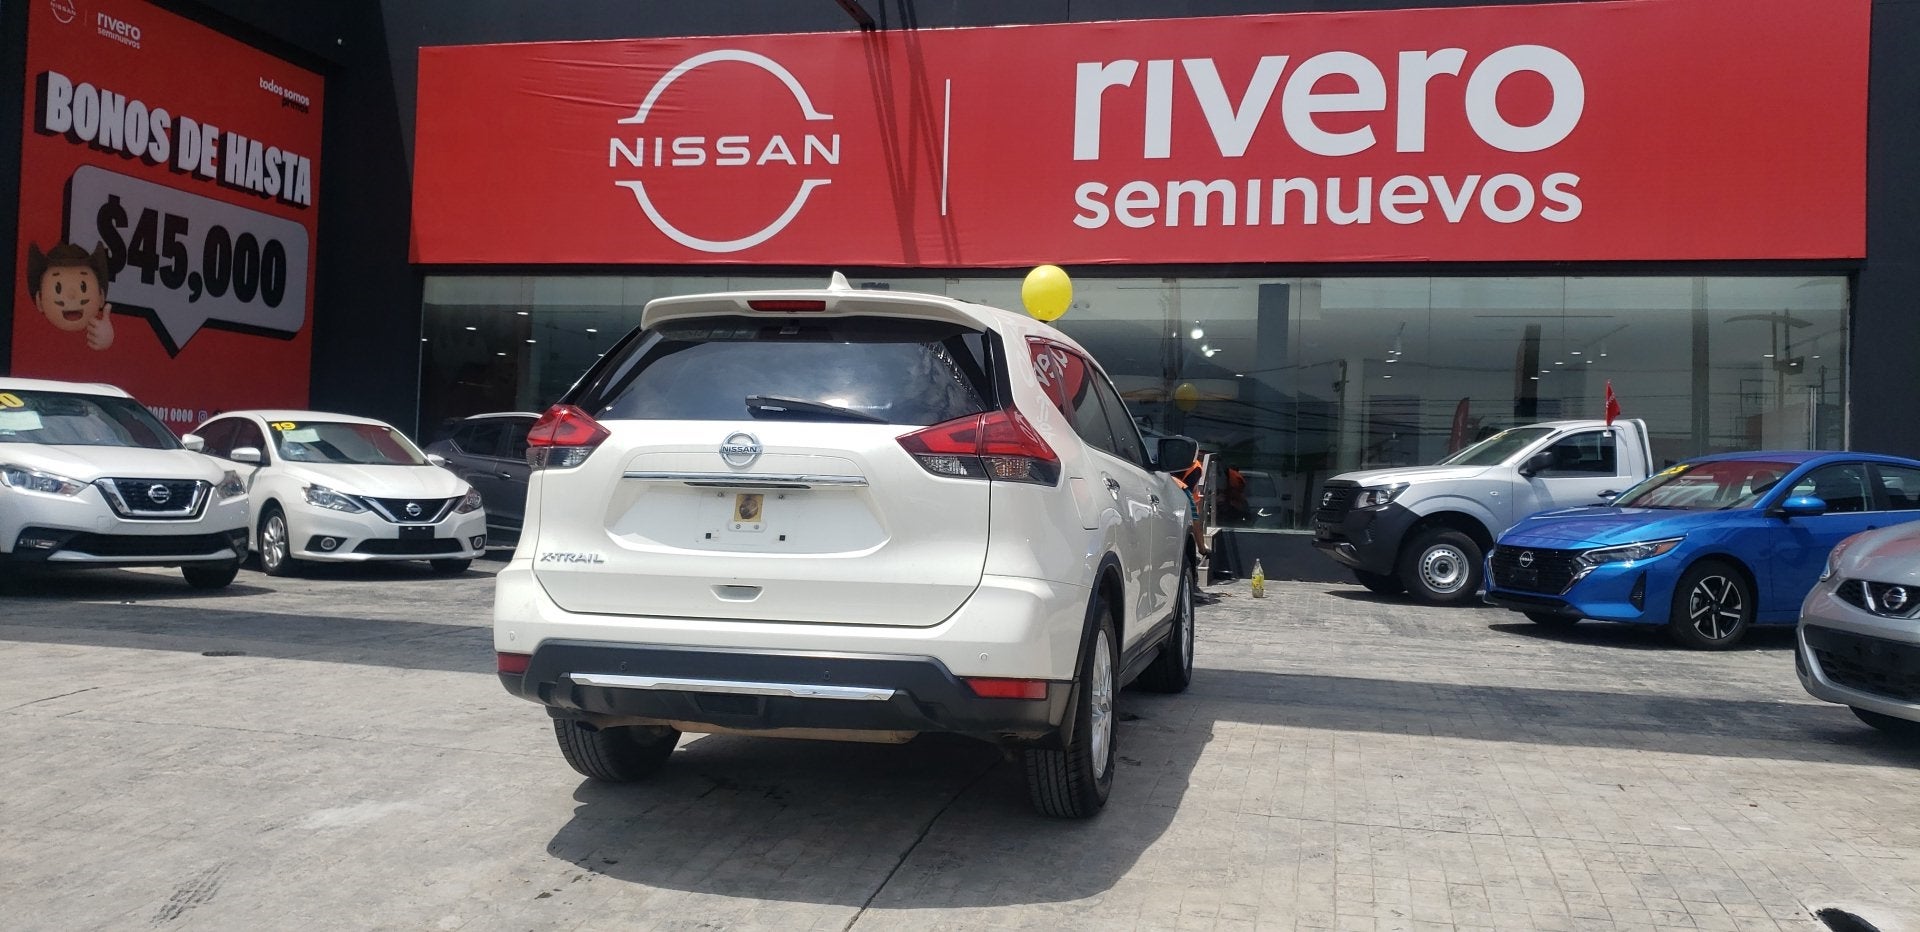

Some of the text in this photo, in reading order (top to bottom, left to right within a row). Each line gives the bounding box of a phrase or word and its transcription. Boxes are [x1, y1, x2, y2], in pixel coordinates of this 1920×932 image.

[97, 12, 141, 40] rivero
[97, 27, 141, 49] seminuevos
[259, 76, 310, 106] todos somos
[1073, 44, 1585, 161] rivero
[45, 70, 311, 207] BONOS DE HASTA
[609, 134, 840, 168] NISSAN
[1072, 172, 1583, 229] seminuevos
[97, 194, 287, 308] $45,000
[271, 422, 296, 431] 19
[540, 552, 605, 564] X-TRAIL
